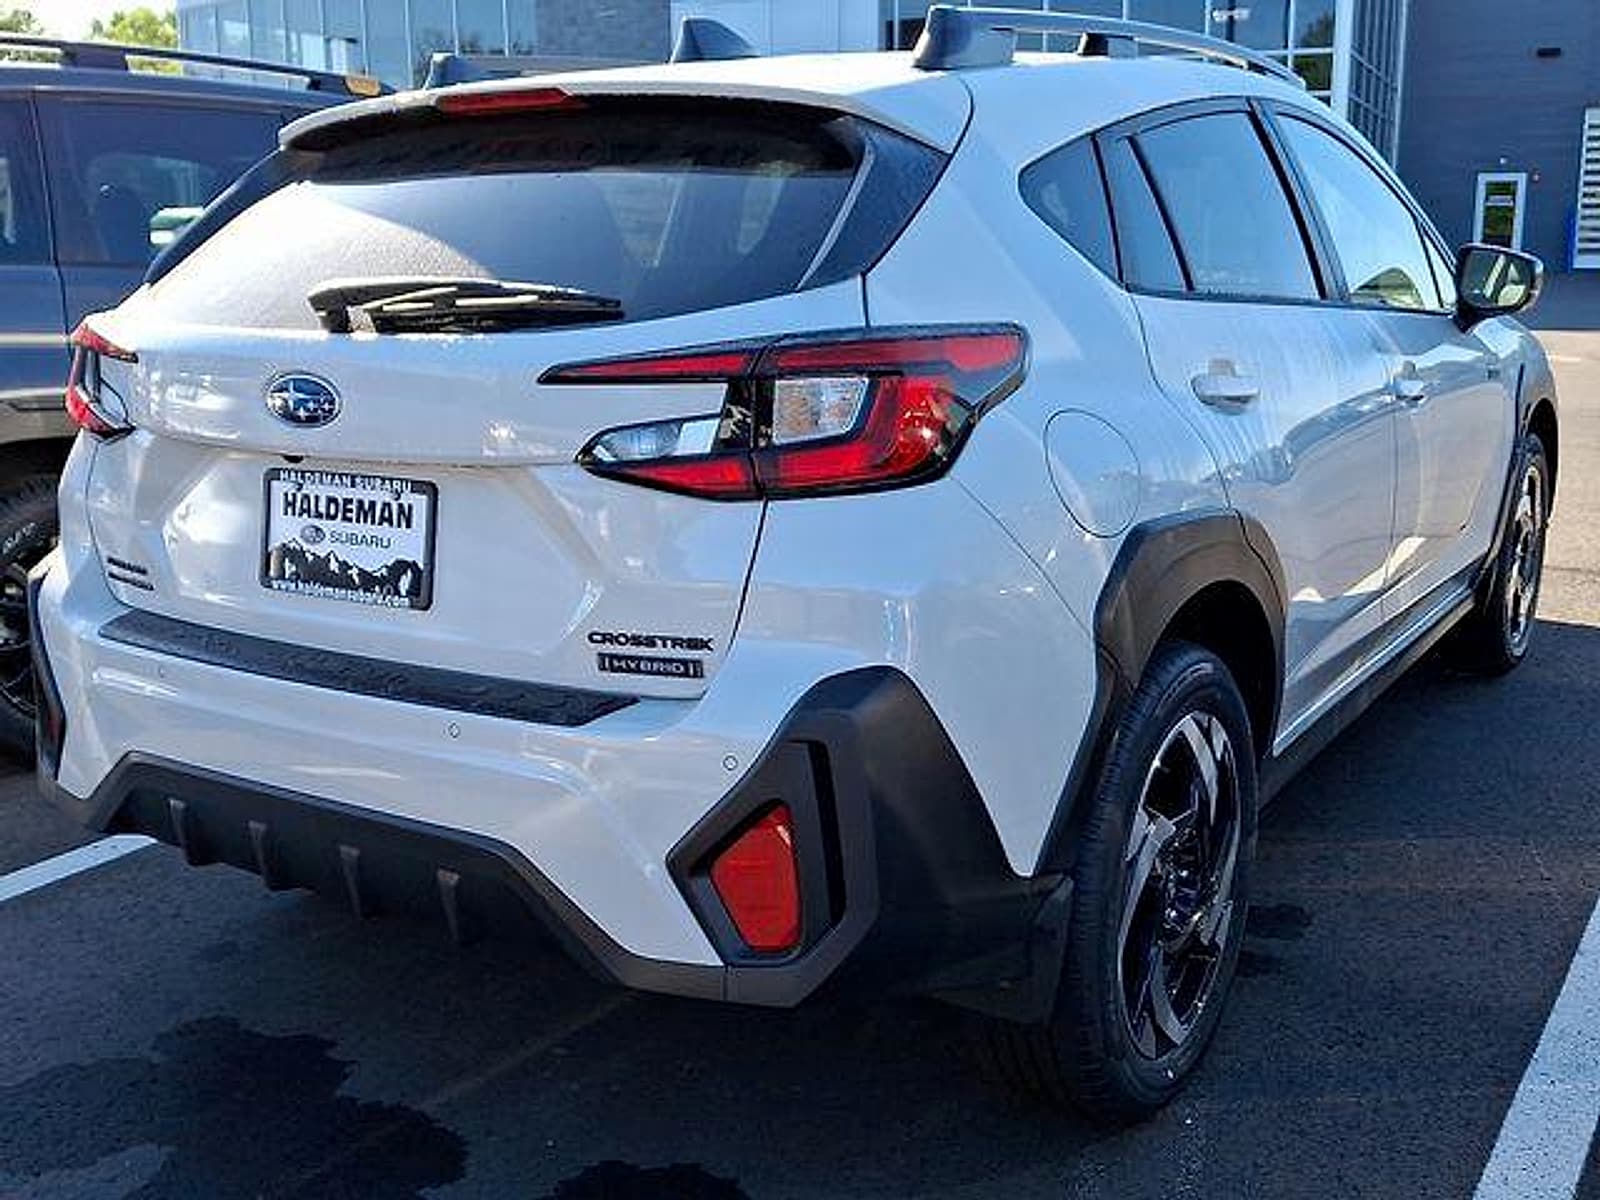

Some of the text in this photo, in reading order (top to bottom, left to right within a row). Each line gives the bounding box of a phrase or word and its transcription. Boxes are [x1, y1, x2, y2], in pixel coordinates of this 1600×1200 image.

[279, 470, 412, 493] HALDEMAN SUBARU
[282, 492, 414, 529] HALDEMAN
[329, 530, 392, 549] SUBARU
[587, 631, 715, 652] CROSSTREK
[612, 658, 686, 674] HYBRID
